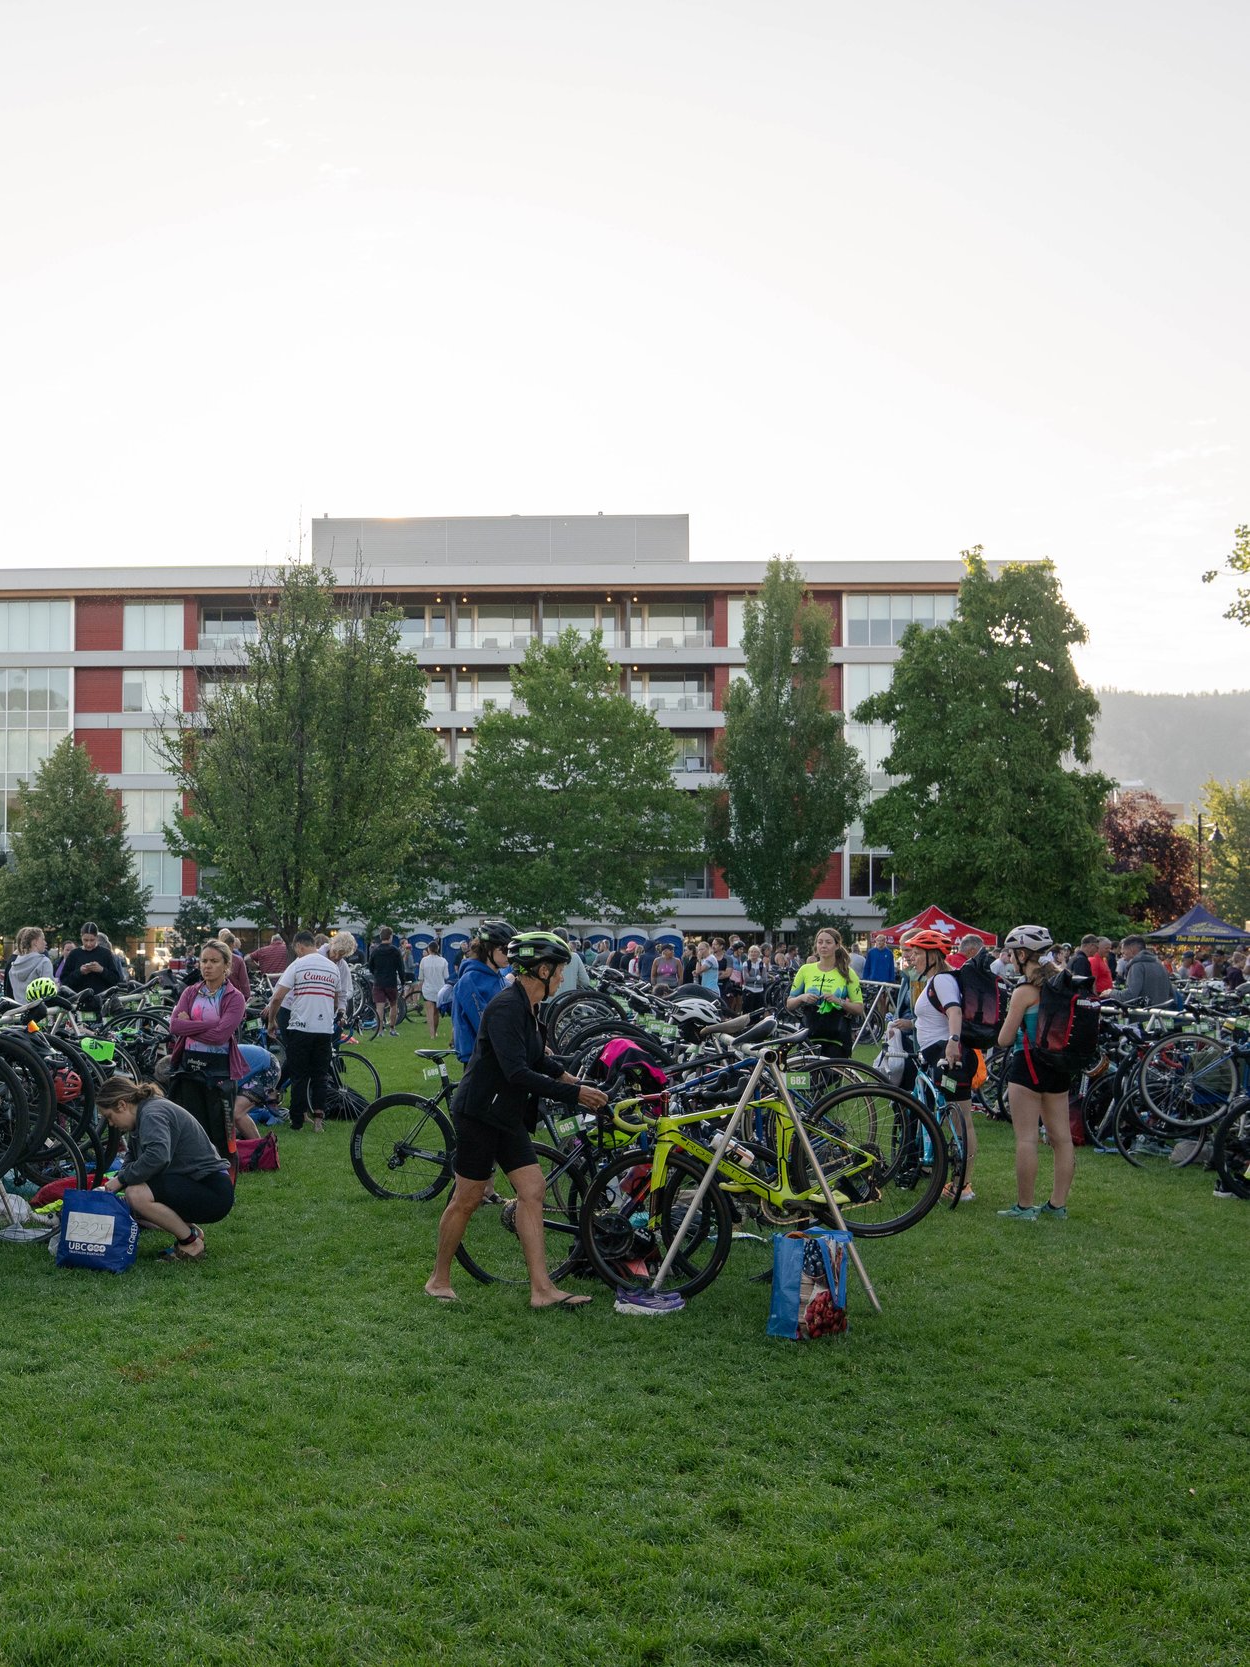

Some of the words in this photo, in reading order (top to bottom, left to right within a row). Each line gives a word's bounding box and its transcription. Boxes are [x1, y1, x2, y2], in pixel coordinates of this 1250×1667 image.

[303, 971, 335, 984] Canada
[790, 1076, 807, 1085] 682
[686, 1140, 749, 1182] ROSETTI
[68, 1241, 87, 1251] UBC
